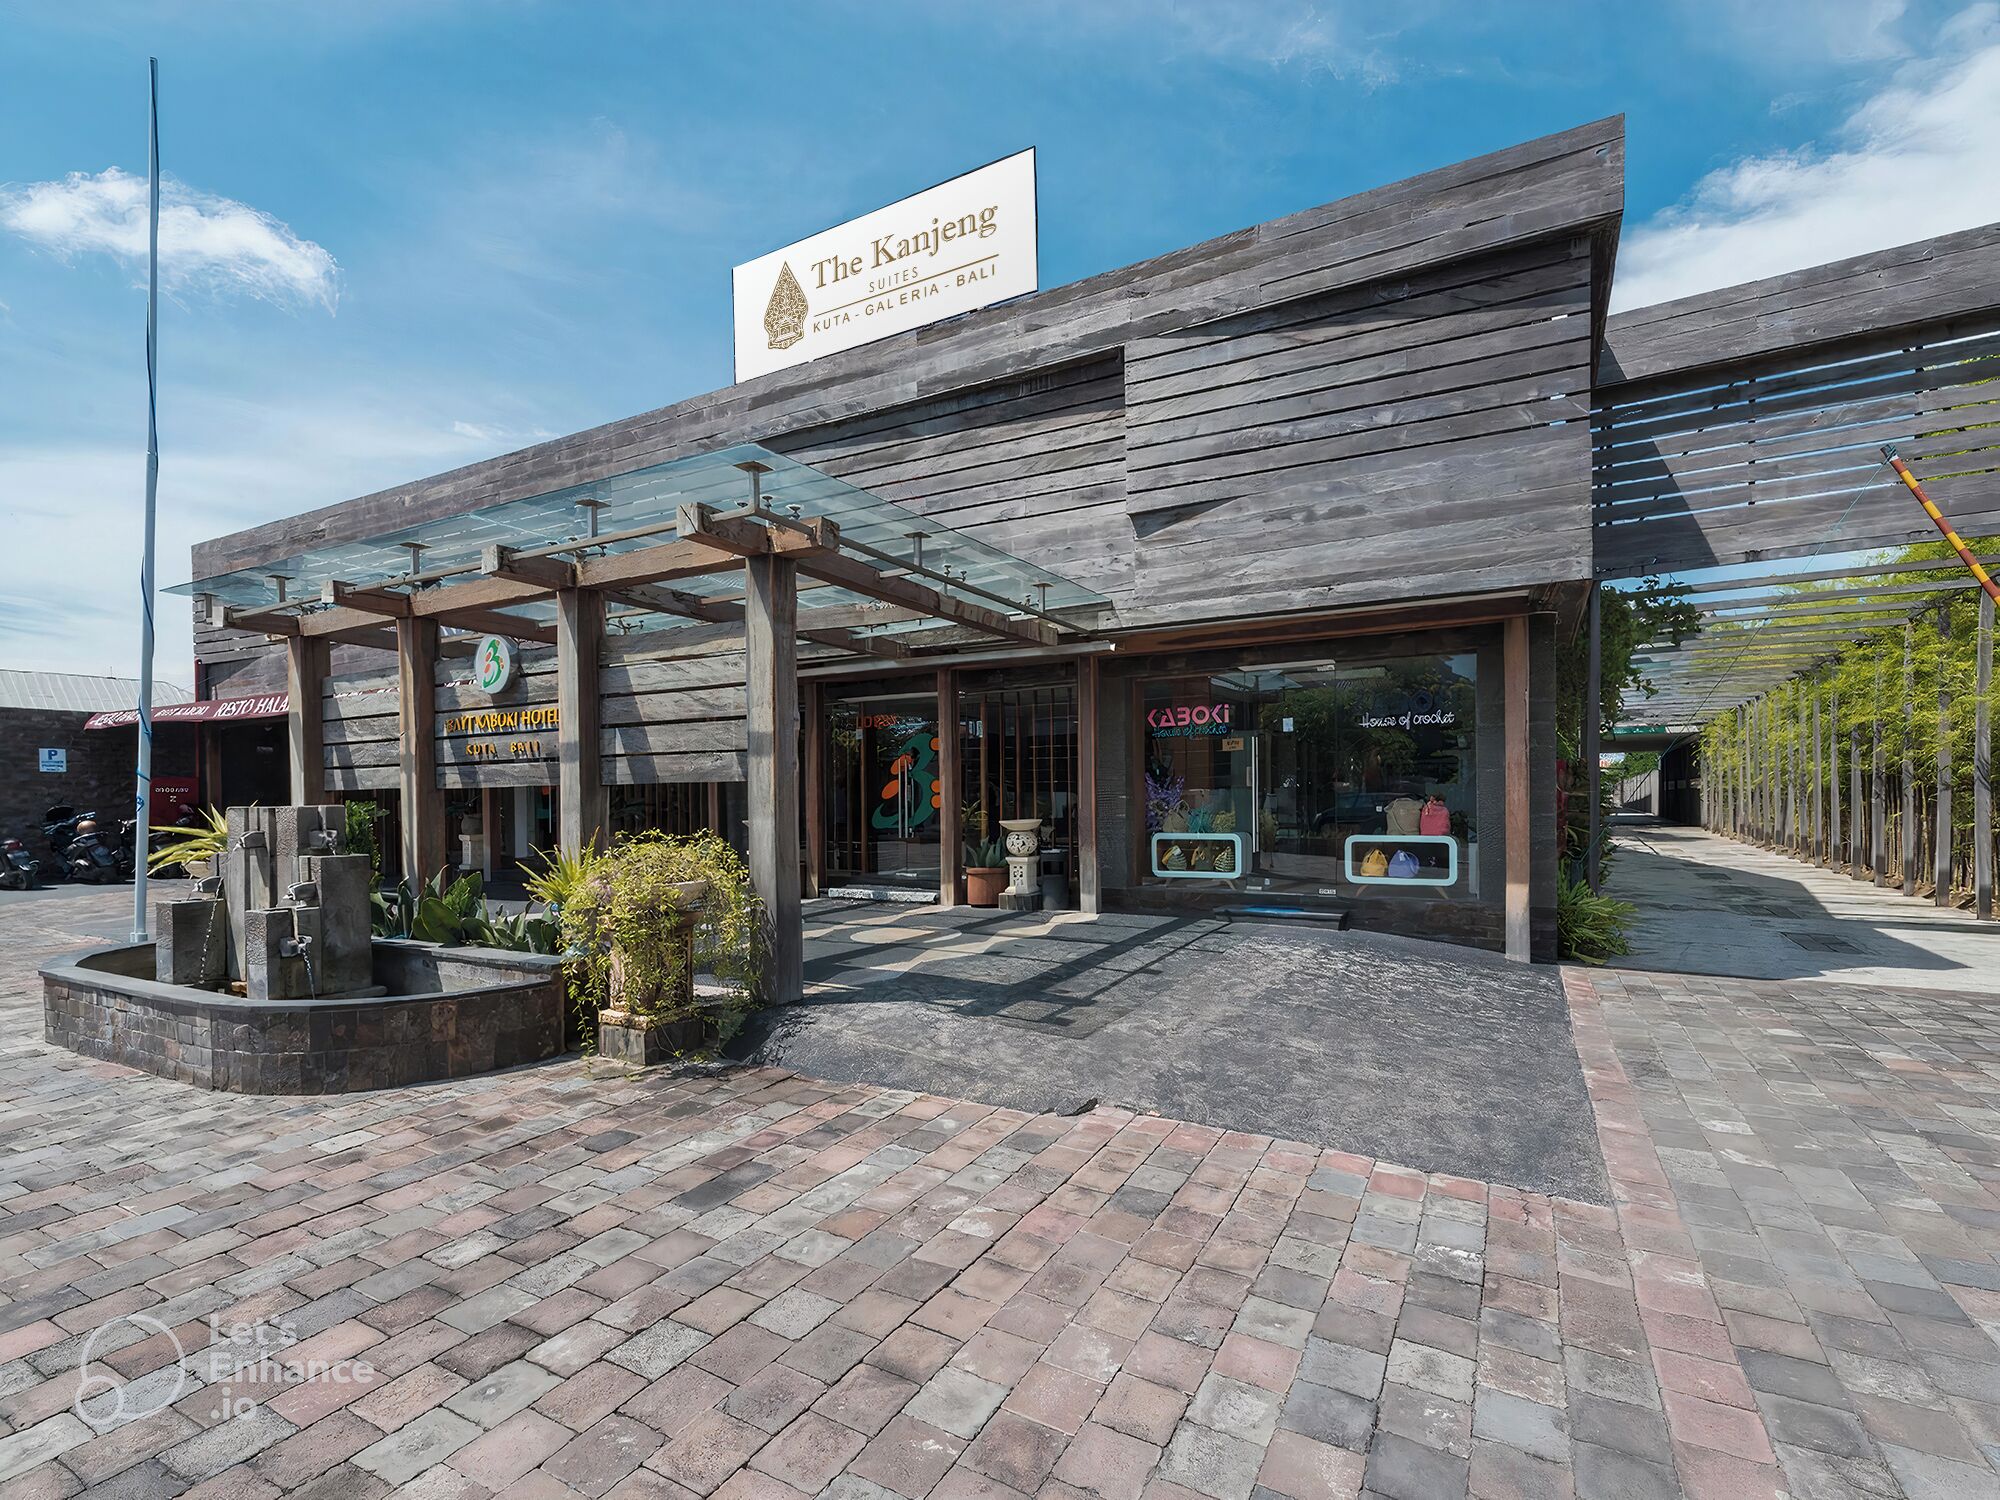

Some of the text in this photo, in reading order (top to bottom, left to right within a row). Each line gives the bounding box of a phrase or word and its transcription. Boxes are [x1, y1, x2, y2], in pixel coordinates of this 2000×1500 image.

[811, 205, 998, 289] The Kanjeng
[869, 266, 919, 293] SUITES
[813, 312, 851, 333] KUTA
[865, 283, 940, 316] GALERIA
[956, 264, 996, 287] BALI
[253, 695, 289, 713] HALA
[475, 711, 519, 730] KABOKI
[521, 707, 559, 726] HOTEL
[1399, 711, 1411, 730] of
[47, 749, 58, 761] P
